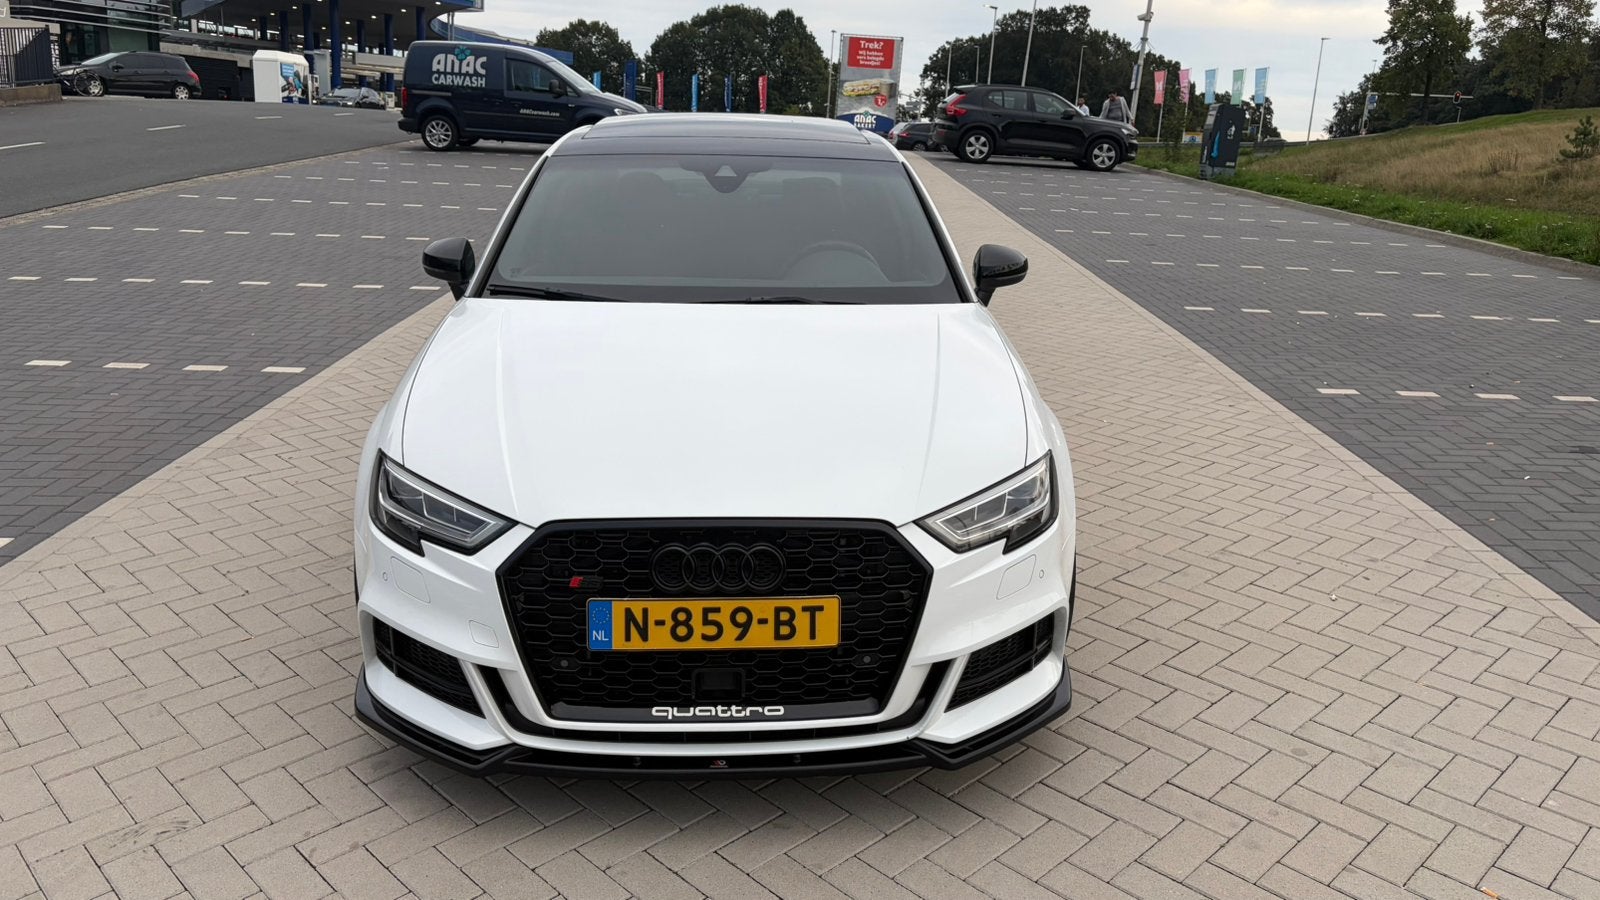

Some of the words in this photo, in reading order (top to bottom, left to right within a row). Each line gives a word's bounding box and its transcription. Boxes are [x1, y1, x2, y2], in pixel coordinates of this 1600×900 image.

[859, 40, 884, 50] Trek?
[432, 53, 487, 75] ANAC
[432, 73, 486, 88] CARWASH
[854, 114, 877, 124] ANAC
[592, 630, 609, 641] NL
[624, 605, 824, 642] N-859-BT
[651, 705, 785, 719] quattro
